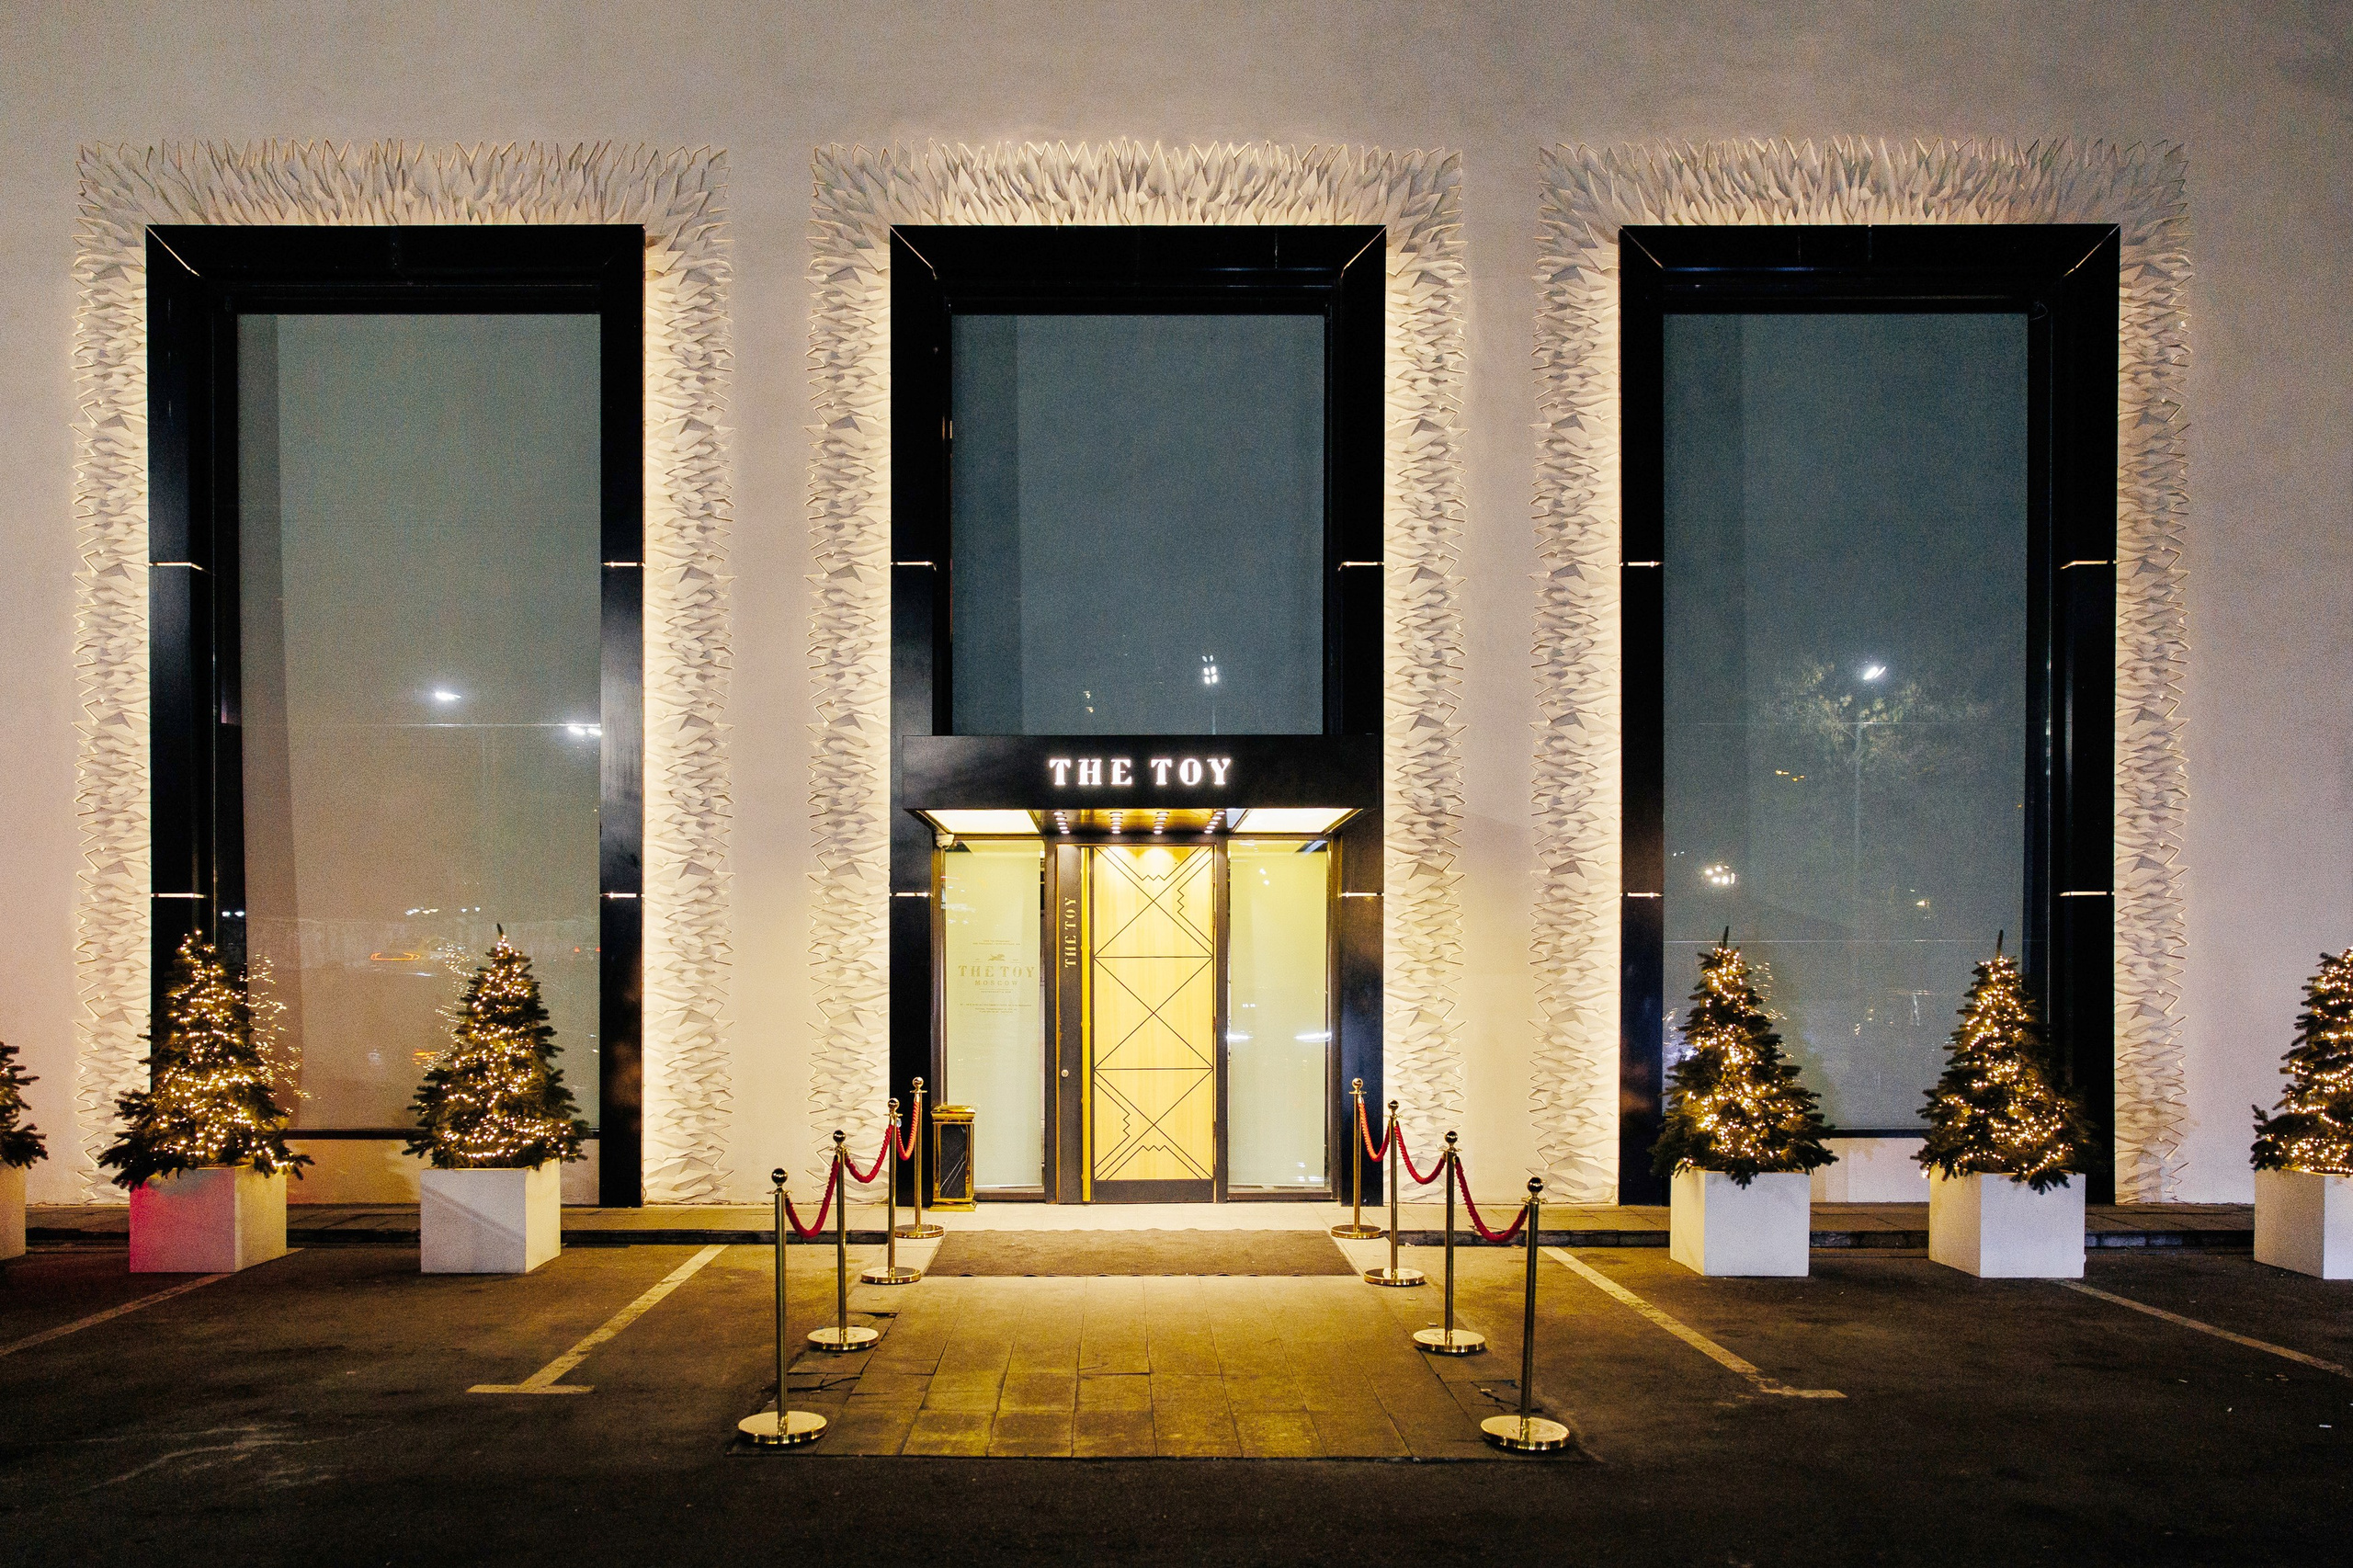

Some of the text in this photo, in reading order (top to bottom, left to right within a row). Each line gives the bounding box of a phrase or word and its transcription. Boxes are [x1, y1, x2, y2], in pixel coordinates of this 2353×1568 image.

[1049, 758, 1232, 786] THE TOY
[1064, 897, 1076, 968] THE TOY
[958, 965, 1035, 979] THE TOY
